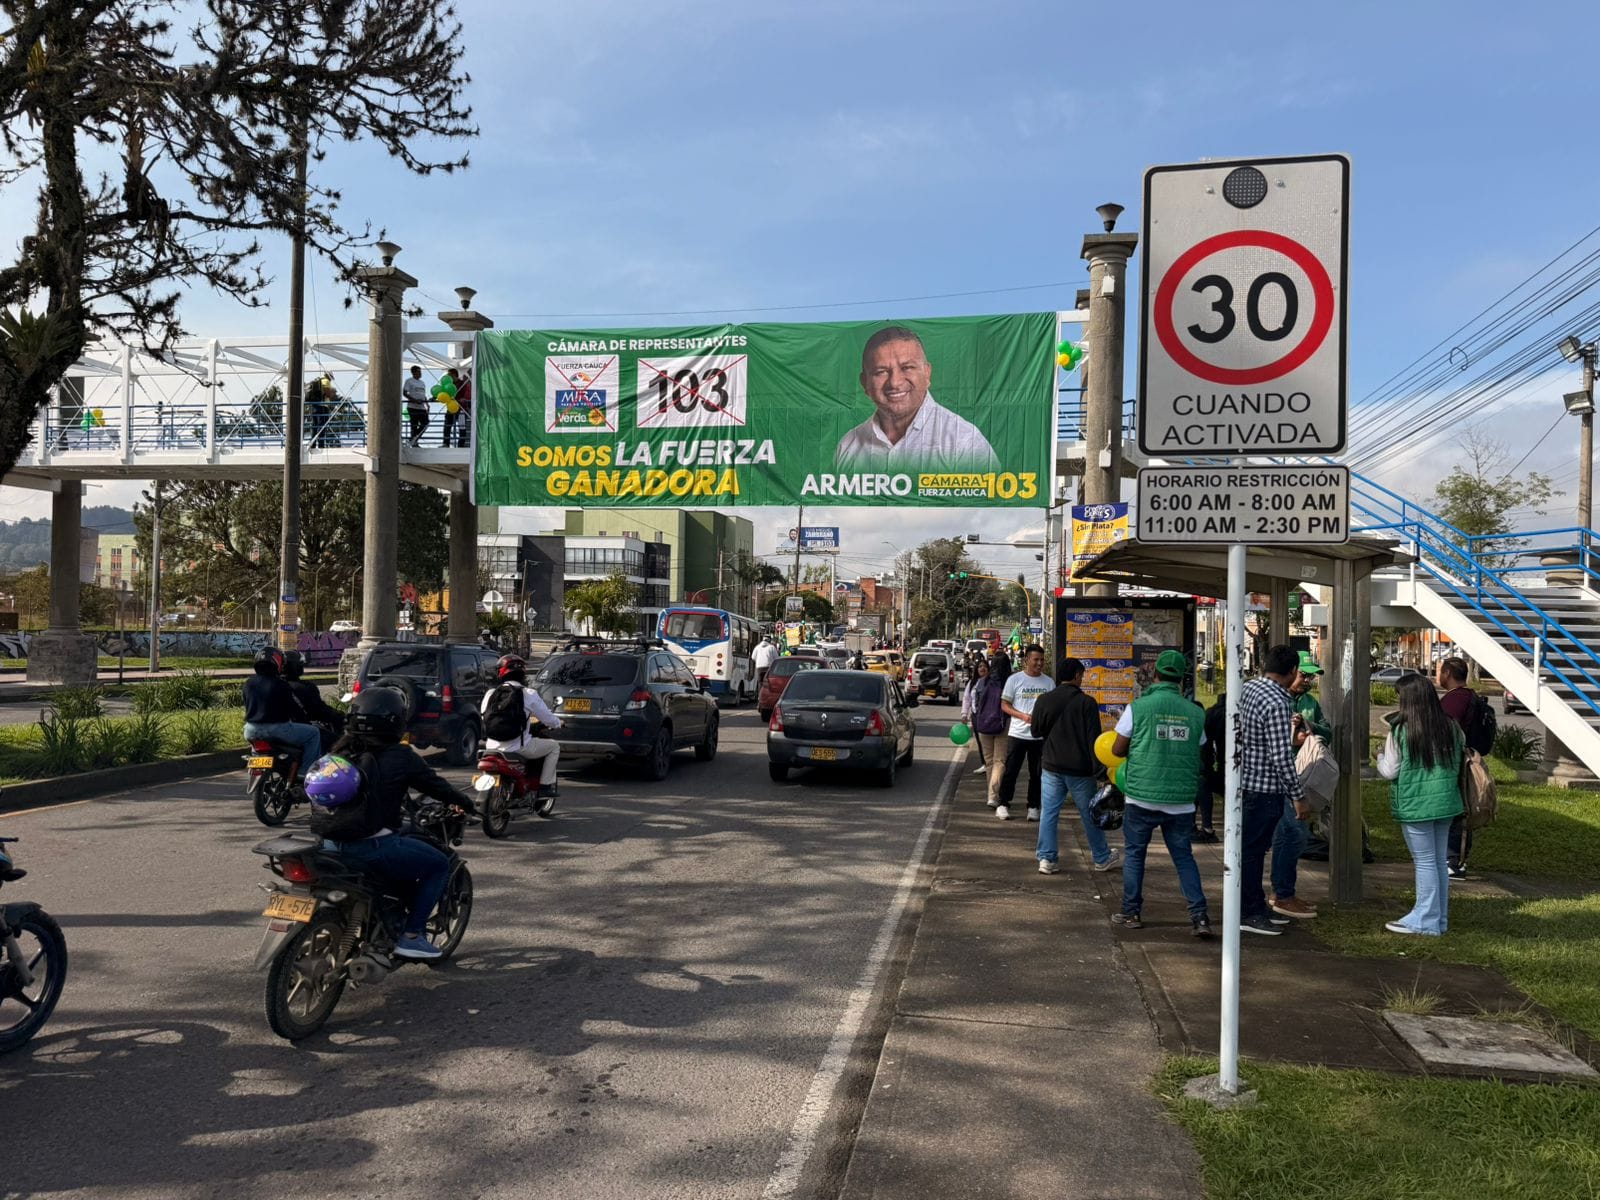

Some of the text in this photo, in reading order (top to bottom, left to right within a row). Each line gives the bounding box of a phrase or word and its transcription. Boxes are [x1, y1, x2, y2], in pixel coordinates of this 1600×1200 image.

[1187, 272, 1299, 343] 30
[547, 335, 748, 353] CÁMARA DE REPRESENTANTES
[561, 391, 601, 403] MIRA
[649, 368, 729, 414] 103
[1173, 392, 1311, 416] CUANDO
[557, 412, 587, 423] Verde
[1161, 422, 1322, 446] ACTIVADA
[517, 439, 777, 468] SOMOS LA FUERZA
[546, 469, 741, 497] GANADORA
[800, 473, 912, 496] ARMERO
[983, 472, 1038, 499] 103
[1147, 471, 1340, 488] HORARIO RESTRICCIÓN
[918, 488, 987, 497] FUERZA CAUCA
[1150, 495, 1193, 511] 6:00
[1198, 495, 1232, 511] AM
[1251, 494, 1295, 511] 8:00
[1302, 494, 1336, 510] AM
[1077, 518, 1114, 532] ¿Sin Plata?
[1145, 518, 1197, 534] 11:00
[1203, 517, 1237, 533] AM
[1256, 517, 1301, 534] 2:30
[1308, 517, 1341, 533] PM
[292, 899, 314, 916] 57E
